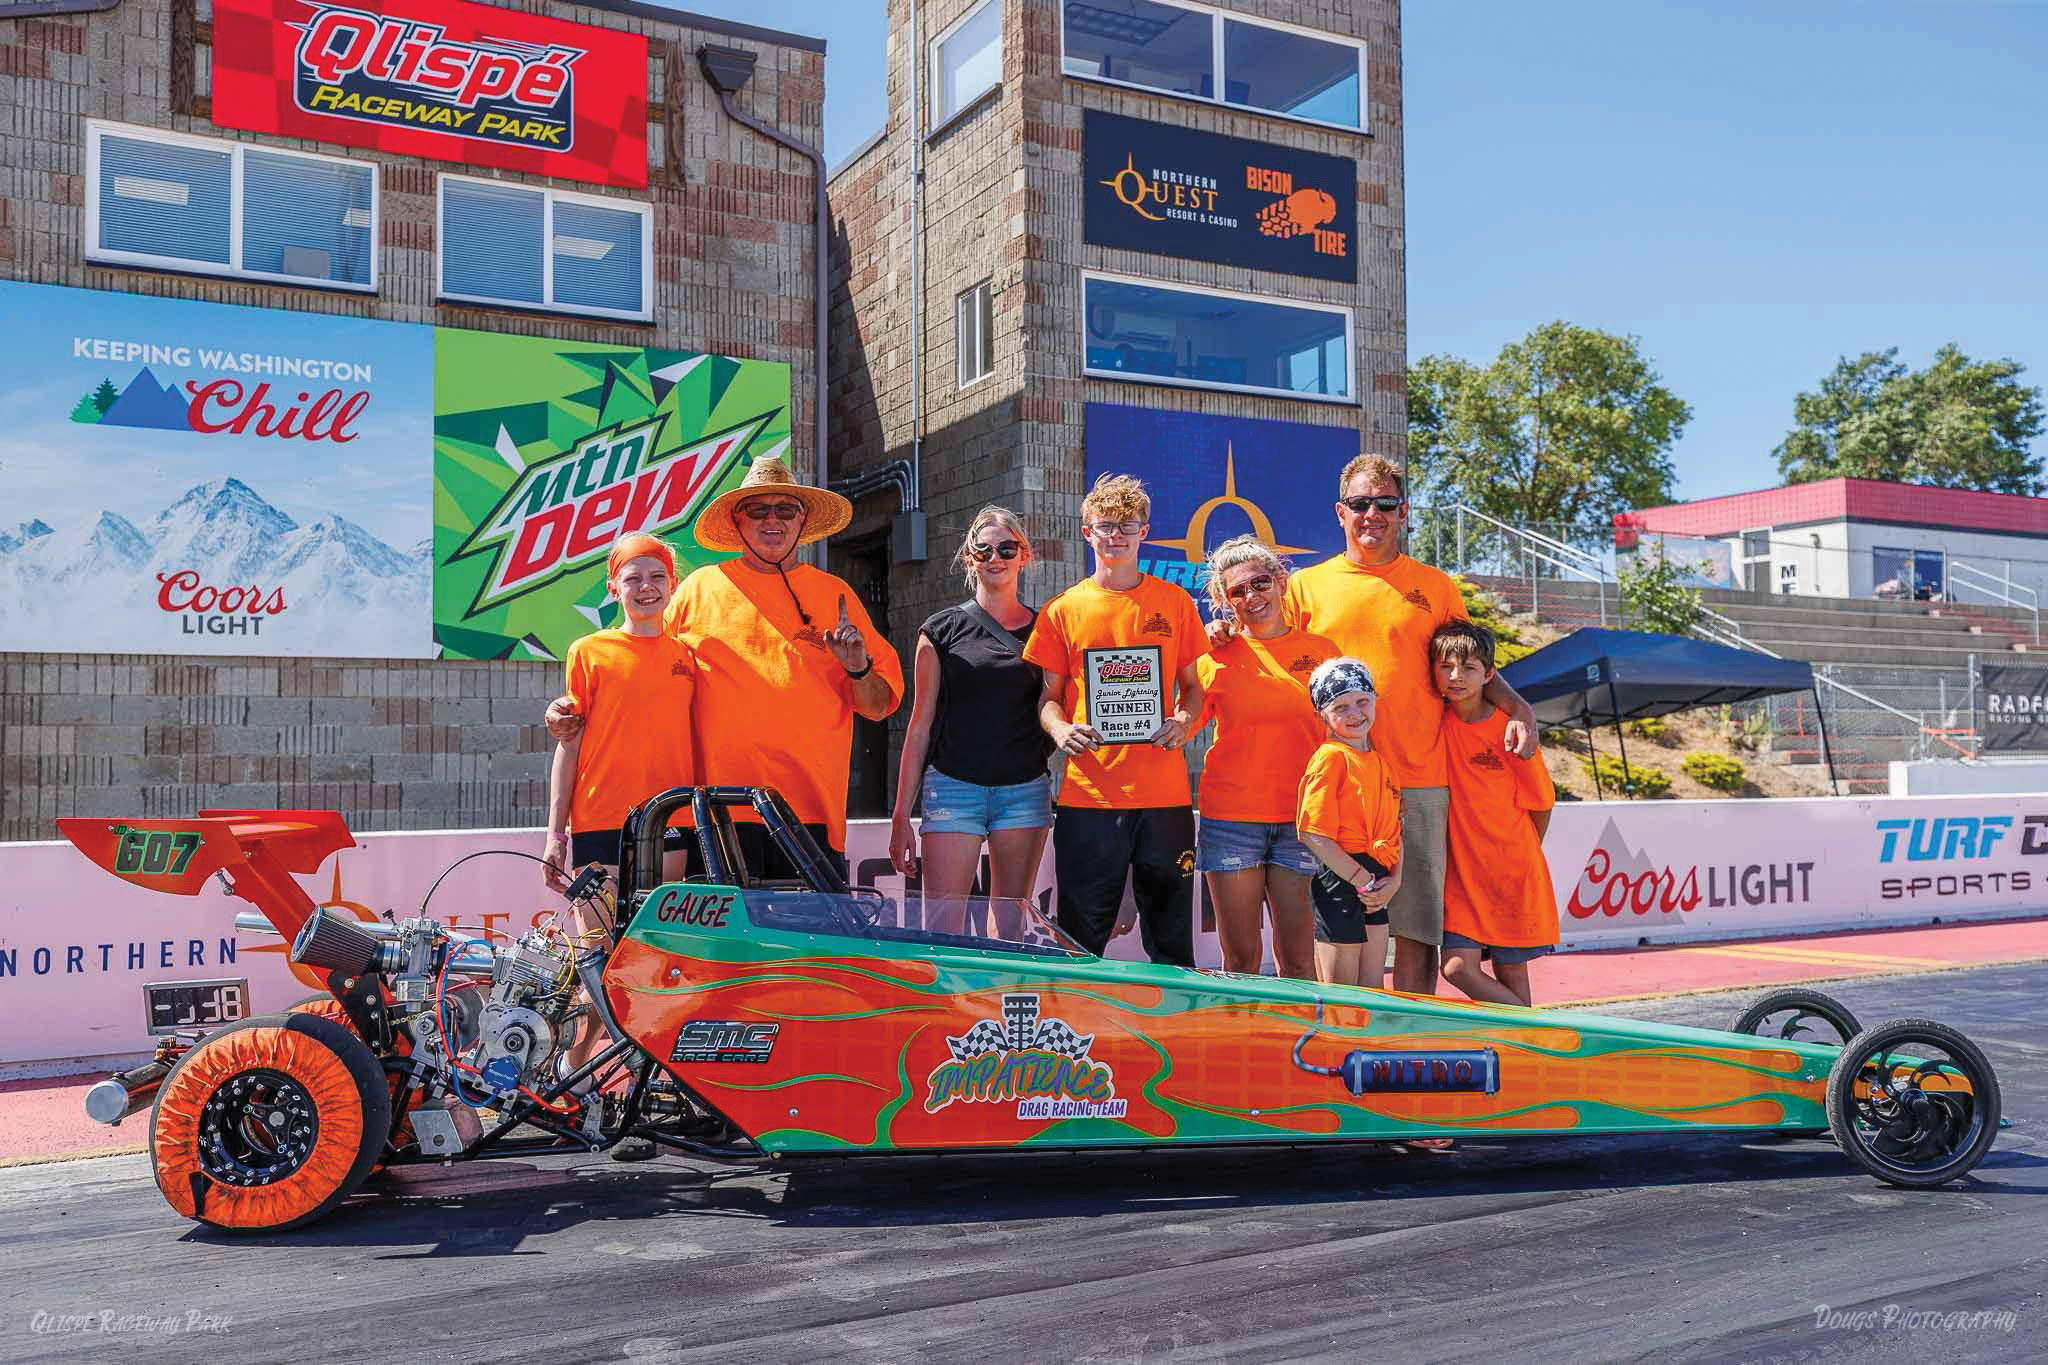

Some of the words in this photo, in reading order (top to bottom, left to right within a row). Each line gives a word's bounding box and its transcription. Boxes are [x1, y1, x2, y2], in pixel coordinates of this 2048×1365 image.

[298, 10, 580, 106] Qlispé
[1099, 151, 1219, 222] QUEST
[1152, 168, 1217, 190] NORTHERN
[1247, 166, 1292, 196] BISON
[1166, 208, 1197, 223] RESORT
[1200, 213, 1206, 223] &
[1208, 215, 1238, 229] CASINO
[1313, 229, 1346, 257] TIRE
[73, 337, 191, 368] KEEPING
[198, 348, 372, 383] WASHINGTON
[185, 378, 371, 443] Chill
[156, 570, 288, 615] Coors
[182, 614, 264, 635] LIGHT
[1096, 689, 1121, 700] Junior
[1122, 688, 1158, 699] Lightning
[1100, 702, 1152, 714] WINNER
[1101, 721, 1130, 731] Race
[1134, 719, 1151, 730] #4
[115, 832, 202, 875] 607
[1876, 816, 2014, 863] TURF
[1567, 847, 1702, 920] Coors
[1707, 861, 1815, 907] LIGHT
[1881, 871, 2031, 899] SPORTS
[657, 889, 735, 928] GAUGE
[0, 937, 237, 977] NORTHERN
[677, 1022, 779, 1050] SMC
[671, 1053, 718, 1062] RACE
[721, 1054, 769, 1062] CARS
[1371, 1059, 1474, 1085] NITRO
[926, 1049, 1111, 1111] IMPATIENCE
[1019, 1102, 1049, 1117] DRAG
[1051, 1101, 1093, 1117] RACING
[1095, 1101, 1125, 1116] TEAM
